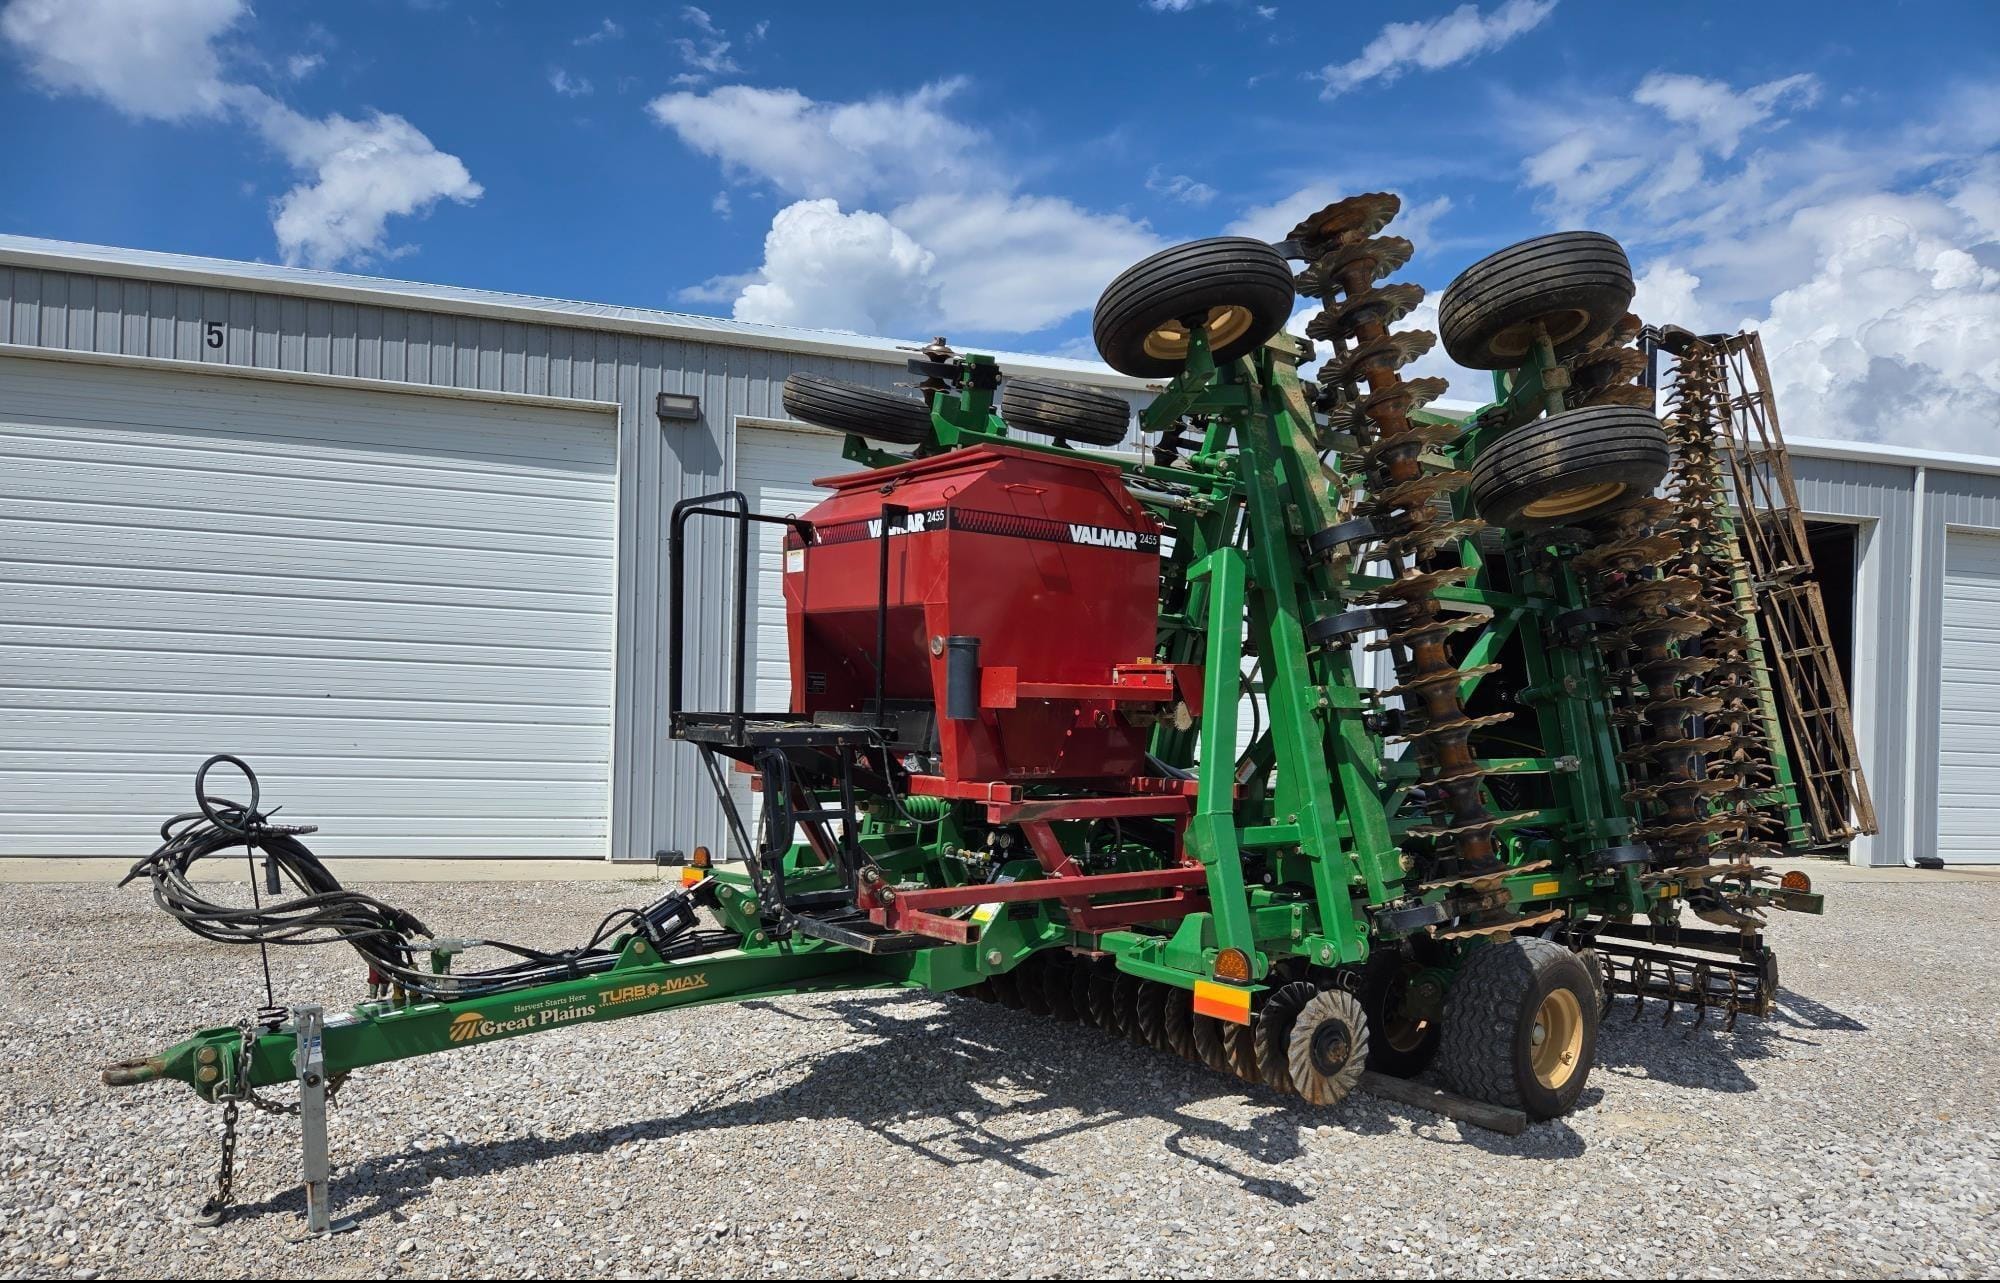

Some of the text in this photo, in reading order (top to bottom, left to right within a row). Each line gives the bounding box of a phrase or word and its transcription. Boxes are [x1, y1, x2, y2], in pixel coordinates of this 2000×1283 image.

[207, 321, 224, 349] 5
[927, 509, 945, 523] 2455
[1069, 523, 1157, 550] VALMAR 2455
[514, 994, 587, 1013] Harvest Starts Here
[480, 1004, 596, 1037] Great Plains
